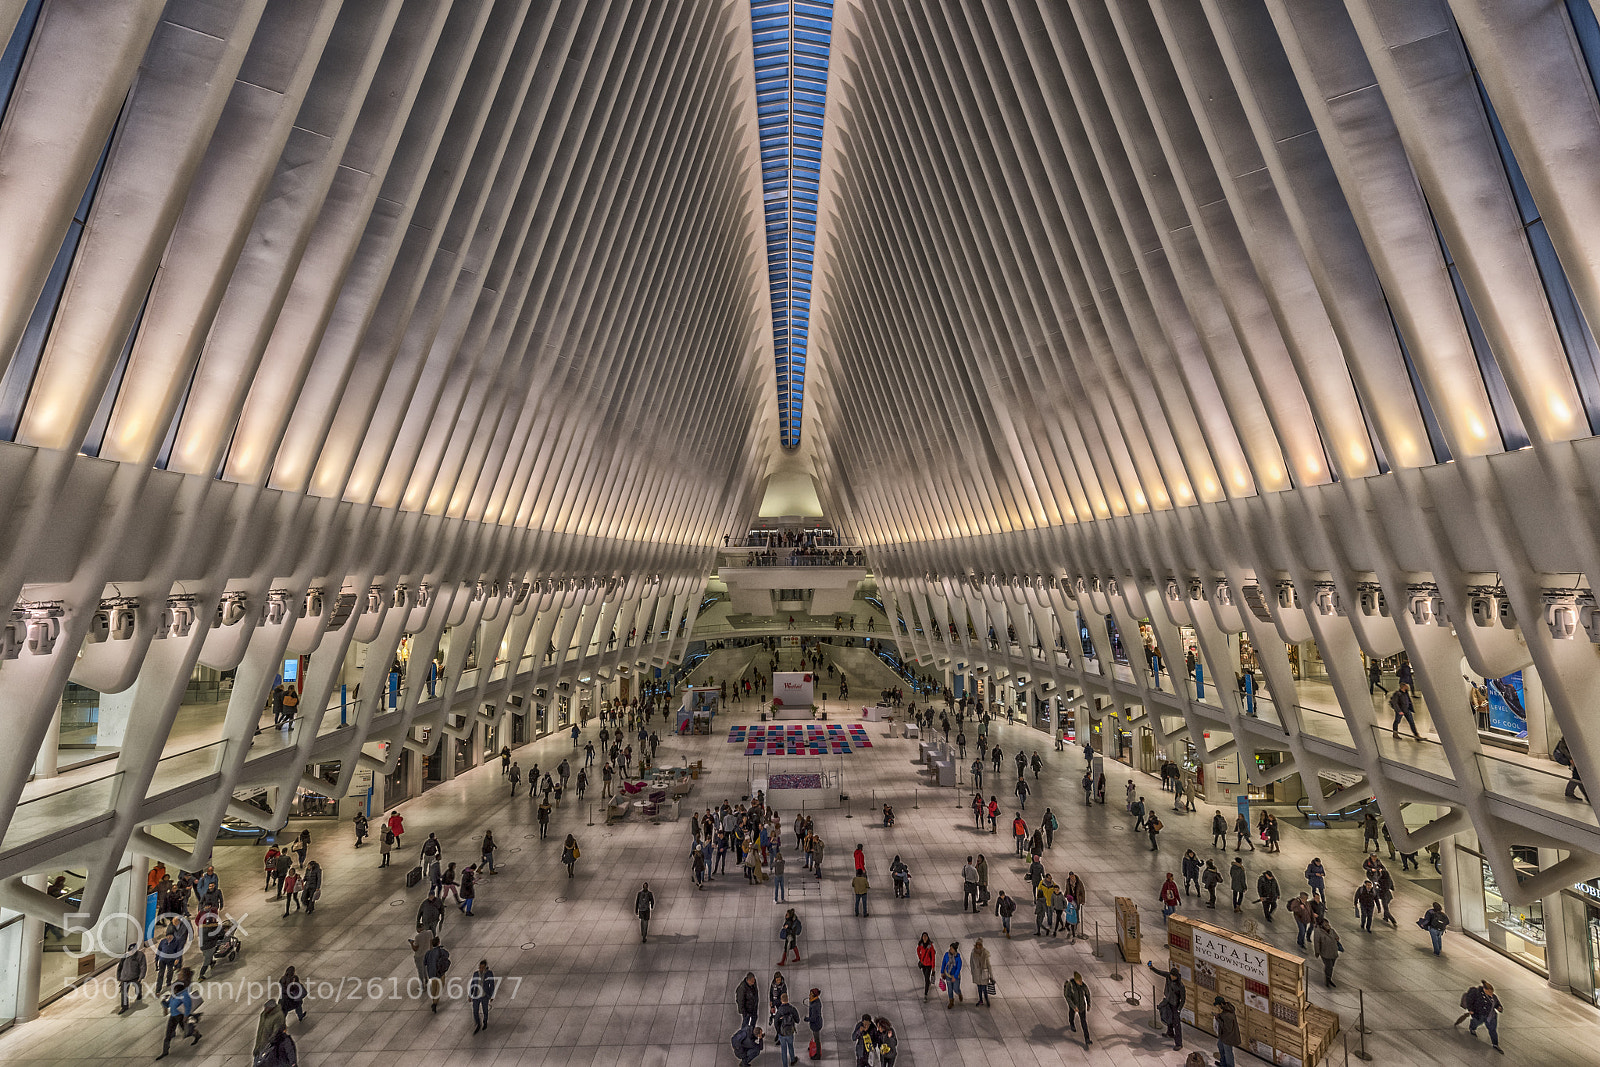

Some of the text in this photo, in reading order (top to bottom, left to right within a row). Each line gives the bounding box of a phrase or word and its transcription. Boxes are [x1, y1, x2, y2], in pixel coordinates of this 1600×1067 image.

[1490, 704, 1509, 713] LEVEL
[1503, 720, 1521, 730] COOL
[1194, 934, 1265, 968] EATALY
[1195, 945, 1265, 977] NYC DOWNTOWN
